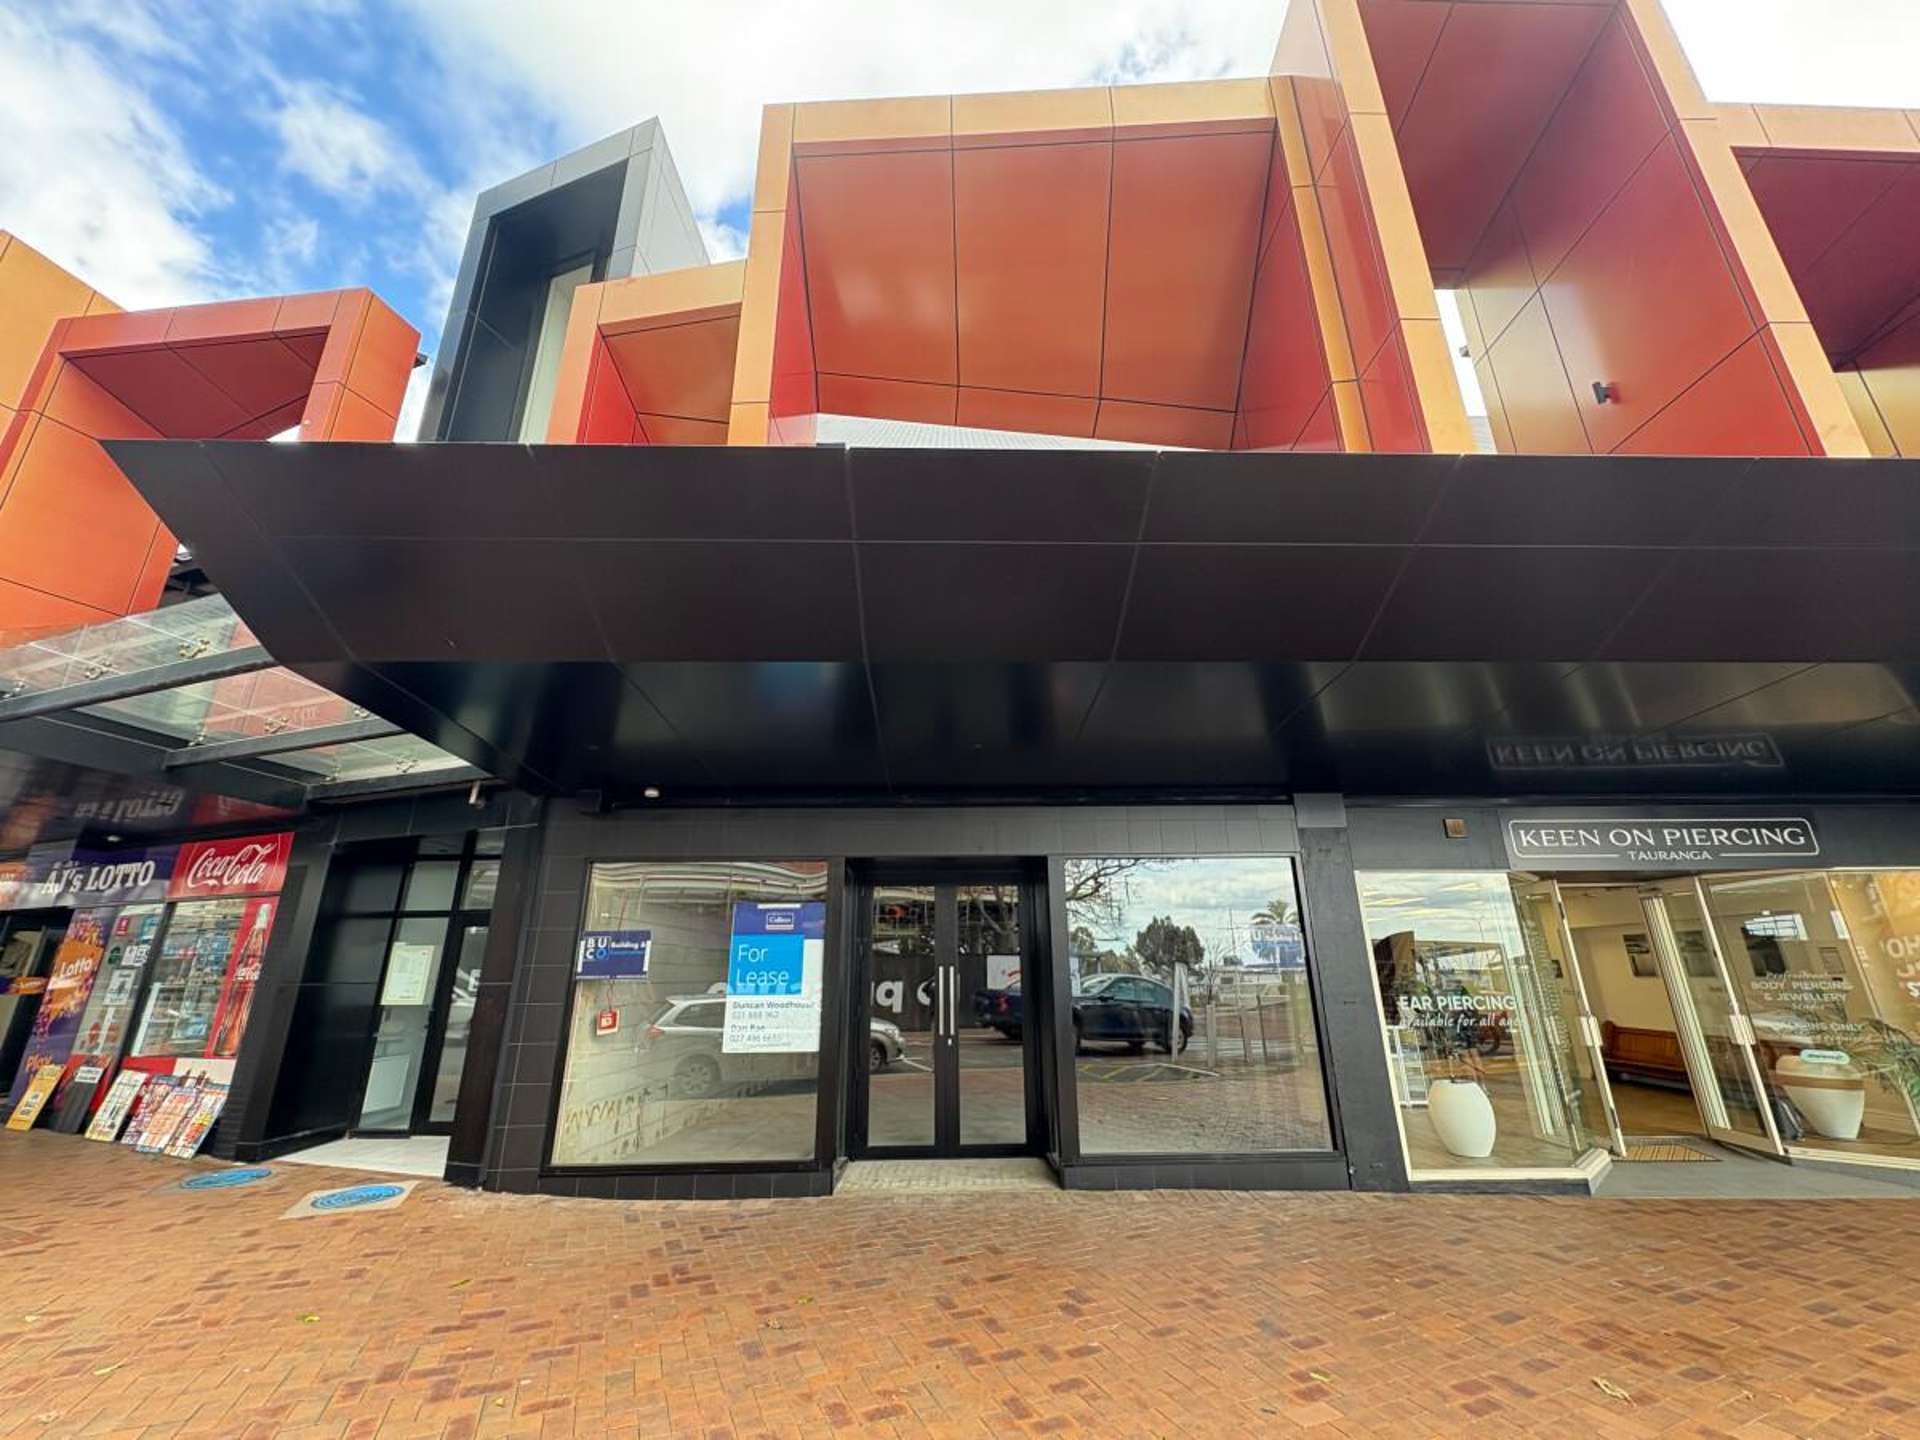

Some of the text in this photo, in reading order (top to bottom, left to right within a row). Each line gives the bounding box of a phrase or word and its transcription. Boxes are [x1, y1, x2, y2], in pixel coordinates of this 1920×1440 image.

[1518, 827, 1806, 848] KEEN ON PIERCING
[1627, 850, 1713, 860] TAURANGA
[85, 861, 156, 891] LOTTO
[737, 944, 768, 962] For
[60, 957, 93, 977] Lotto
[736, 968, 789, 986] Lease
[1398, 995, 1517, 1010] EAR PIERCING
[1455, 1013, 1475, 1032] for
[1480, 1011, 1495, 1026] all
